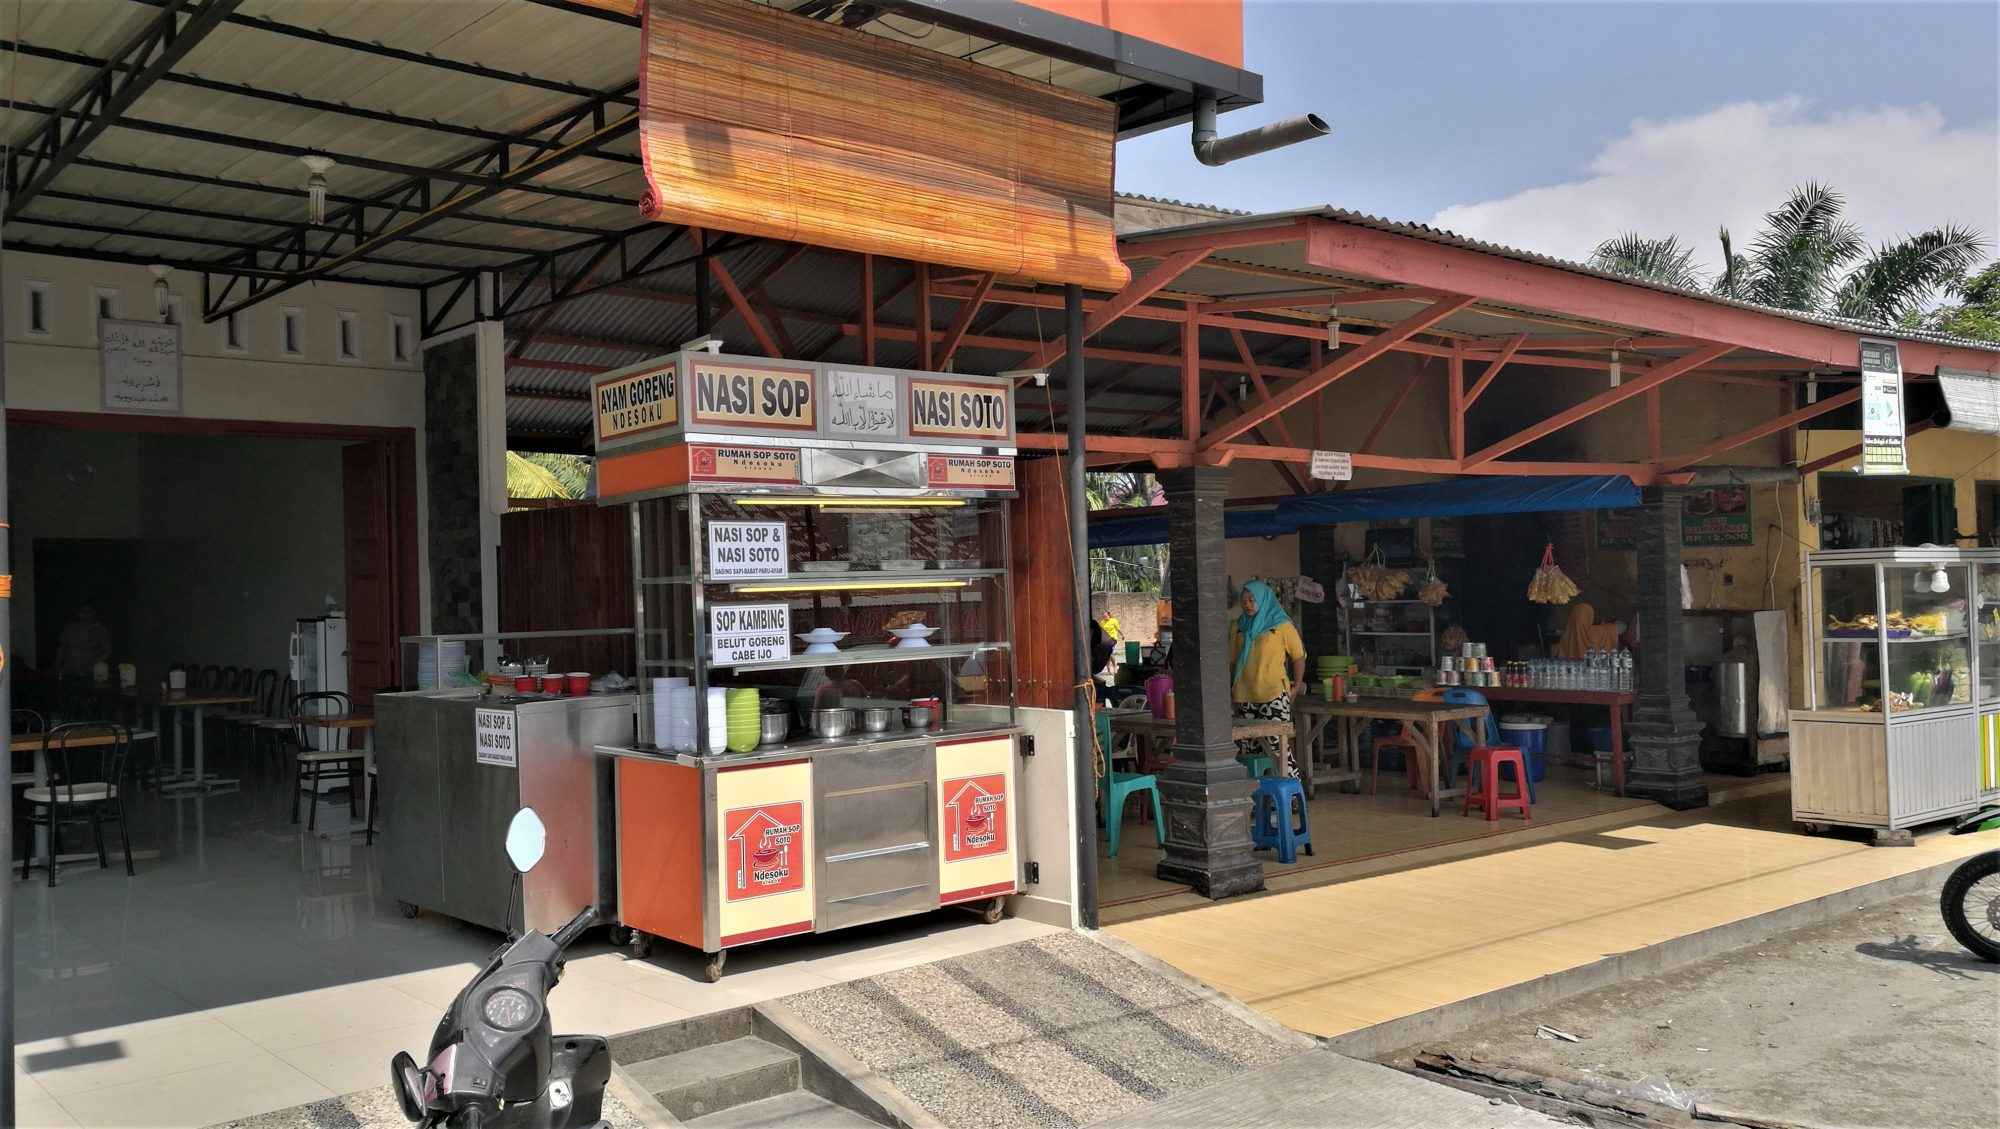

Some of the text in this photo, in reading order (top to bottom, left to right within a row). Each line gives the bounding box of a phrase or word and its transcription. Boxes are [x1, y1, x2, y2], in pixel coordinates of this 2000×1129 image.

[601, 372, 674, 414] AYAM GORENG
[697, 372, 810, 418] NASI SOP
[613, 404, 662, 430] NDESOKU
[914, 389, 1005, 430] NASI SOTO
[718, 449, 796, 461] RUMAH SOP SOTO
[948, 459, 1011, 469] RUMAH SOP SOTO
[714, 527, 781, 543] NASI SOP &
[717, 547, 780, 563] NASI SOTO
[716, 608, 785, 632] SOP KAMBING
[717, 636, 785, 649] BELUT GORENG
[731, 649, 772, 660] CABE IJO
[478, 713, 512, 730] NASI SOP &
[479, 732, 511, 750] NASI SOTO
[766, 825, 801, 835] RUMAH SOP
[775, 836, 791, 844] SOTO
[966, 833, 995, 844] Ndesoku
[754, 868, 788, 881] Ndesoku
